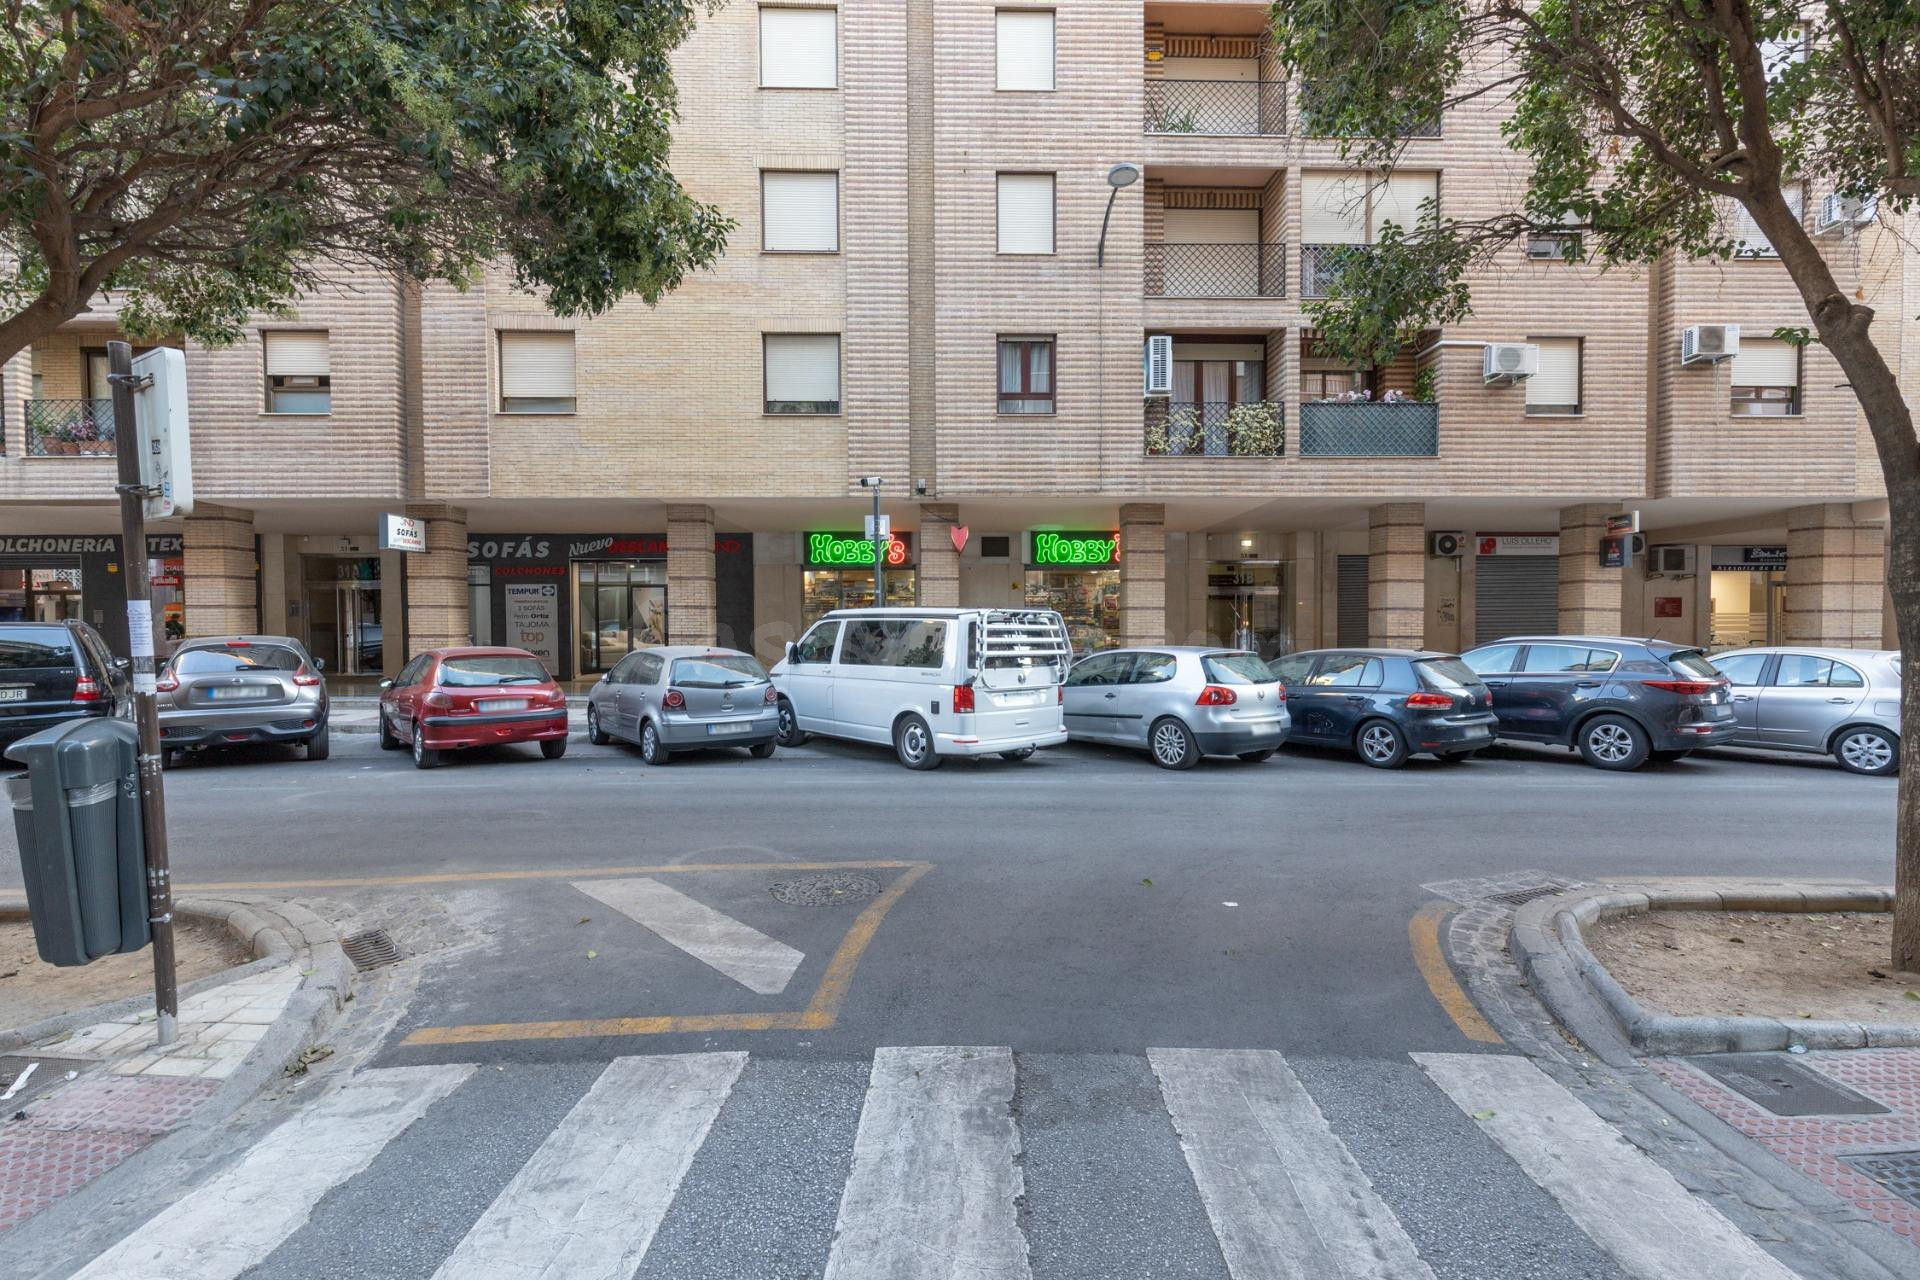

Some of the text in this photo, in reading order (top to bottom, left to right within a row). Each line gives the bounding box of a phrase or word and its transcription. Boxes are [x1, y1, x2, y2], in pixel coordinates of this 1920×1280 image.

[396, 527, 418, 539] SOFÁS
[568, 536, 614, 557] Nuevo
[1502, 536, 1519, 545] LUIS
[467, 535, 550, 559] SOFÁS
[495, 566, 568, 577] COLCHONES
